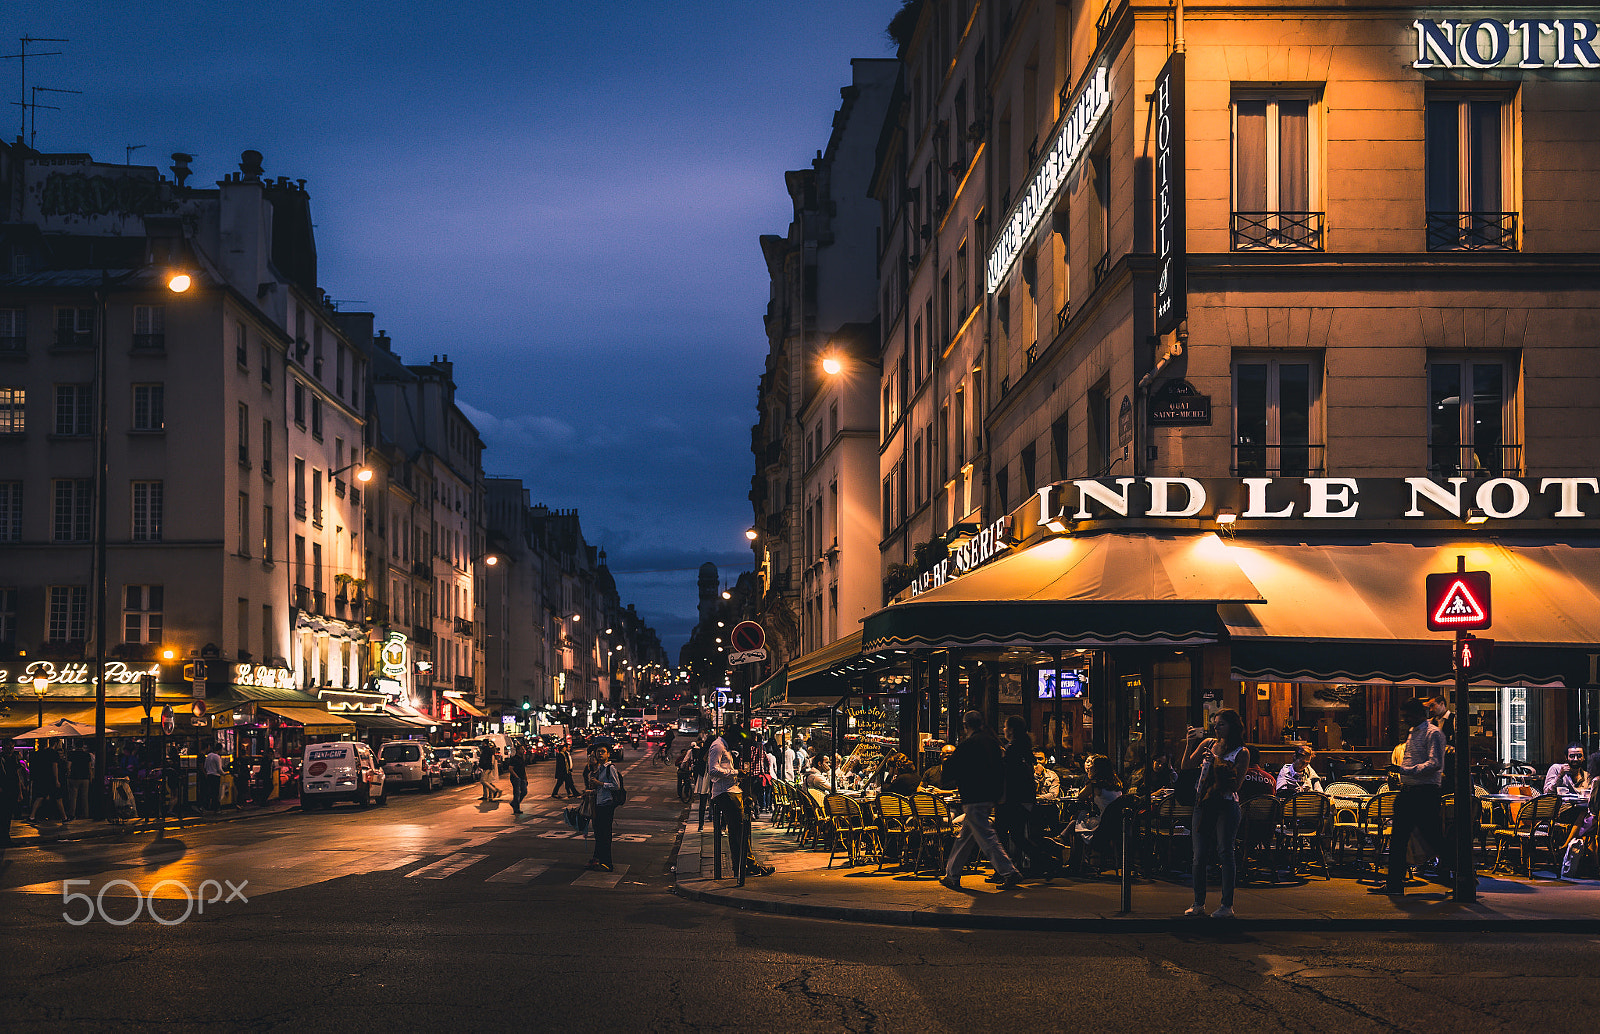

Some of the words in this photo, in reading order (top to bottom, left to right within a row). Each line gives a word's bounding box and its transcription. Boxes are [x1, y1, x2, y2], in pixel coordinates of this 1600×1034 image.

[1412, 18, 1600, 69] NOTR
[1056, 67, 1110, 181] HOTEL
[1158, 73, 1171, 260] HOTEL
[1153, 410, 1207, 419] SAINT-MICHEL
[1169, 402, 1190, 411] QUAI
[1242, 478, 1360, 517] LE
[1404, 477, 1600, 519] NOT
[933, 515, 1008, 589] BRSSERIE
[1245, 774, 1275, 787] ONDON
